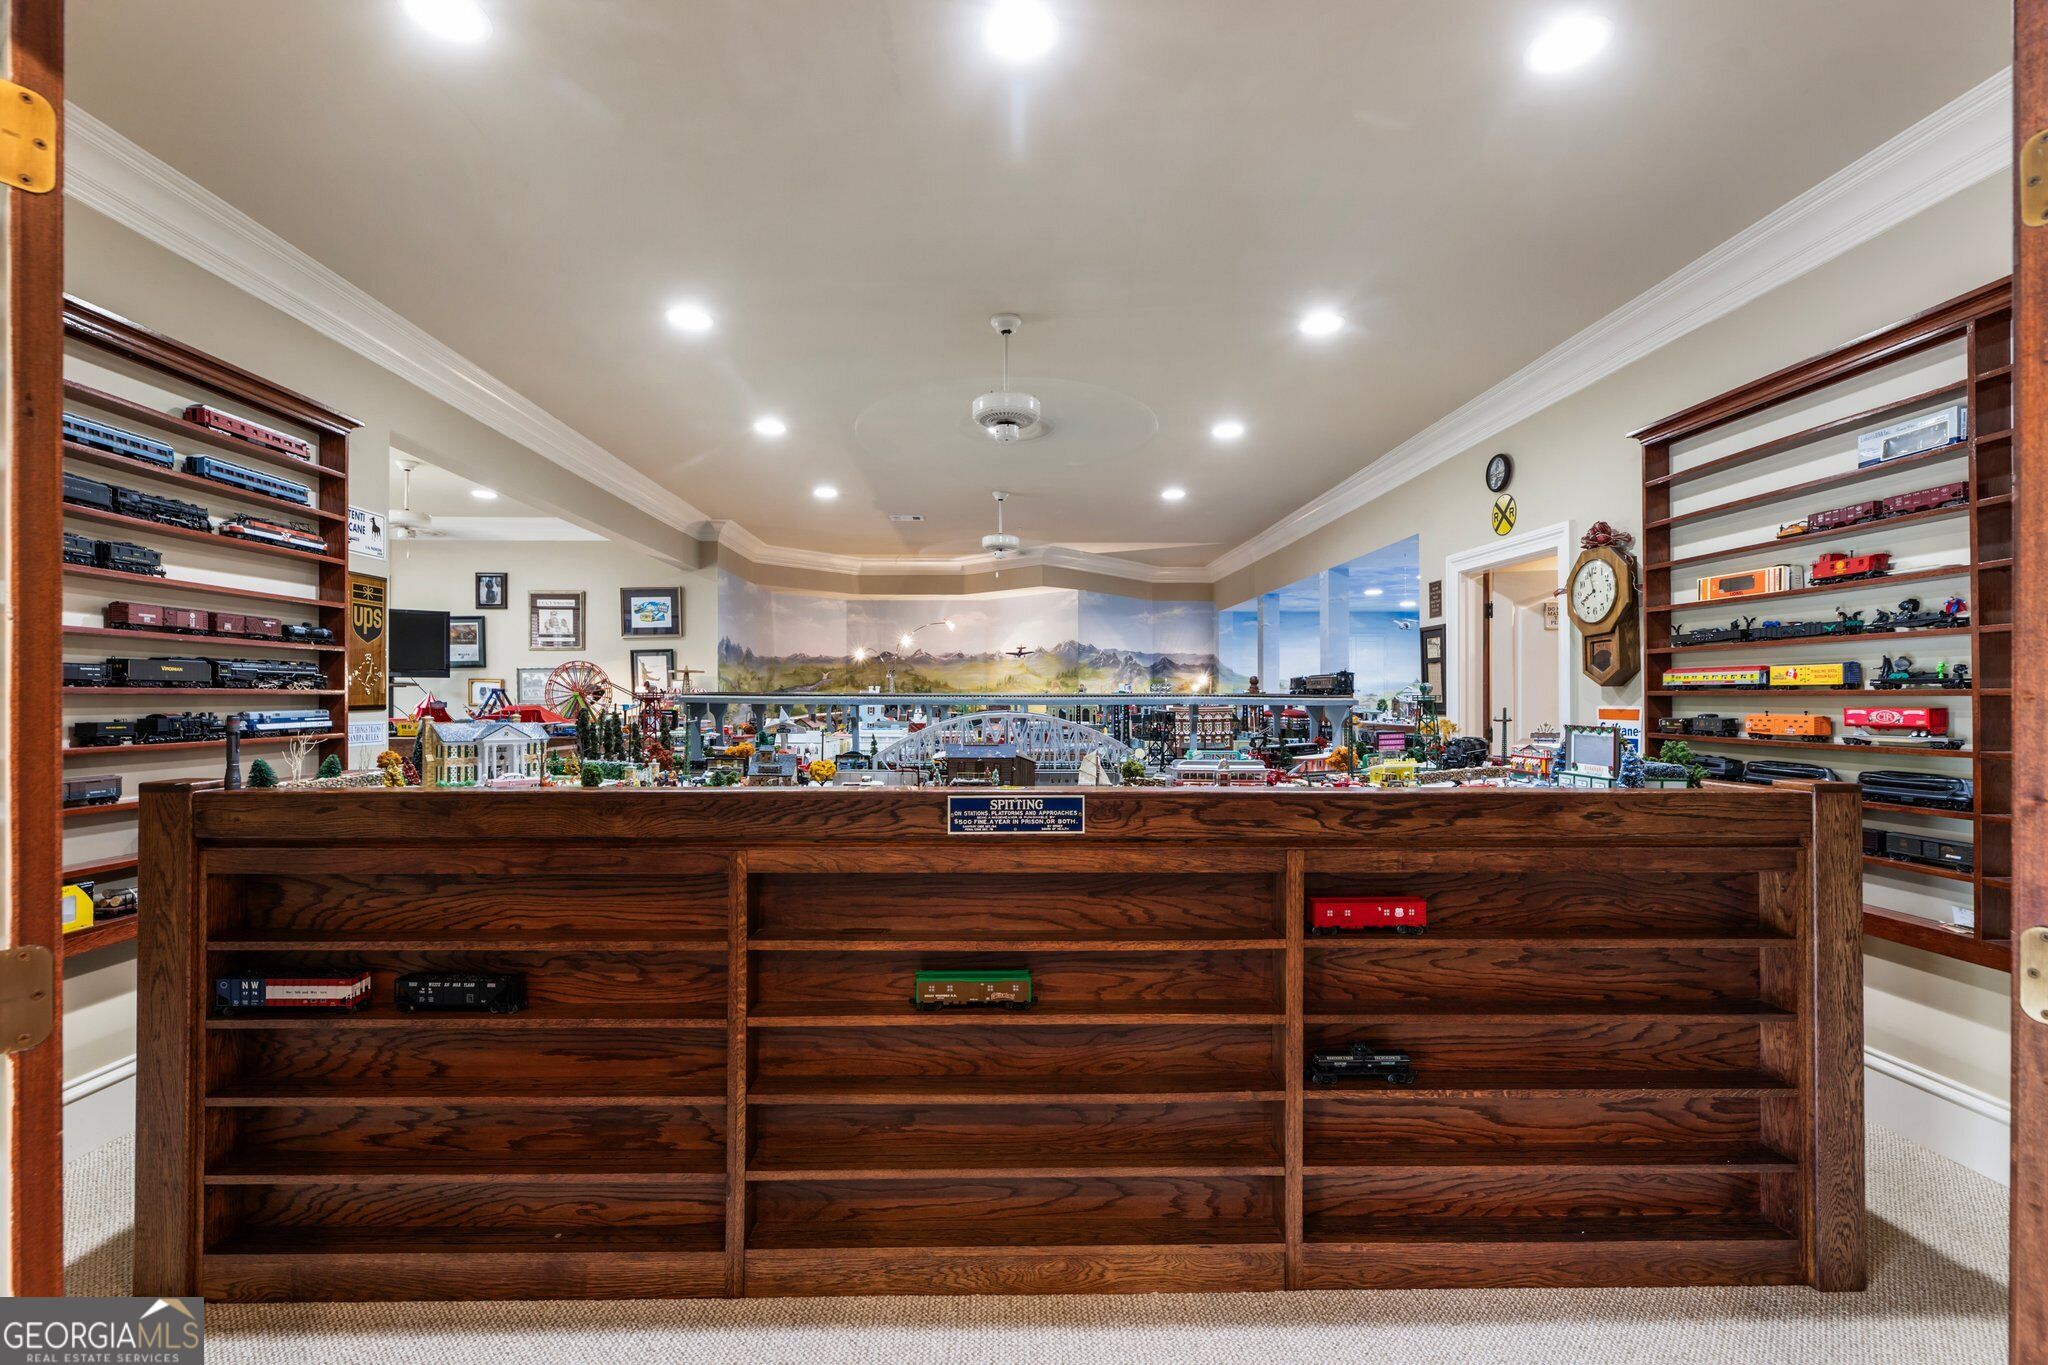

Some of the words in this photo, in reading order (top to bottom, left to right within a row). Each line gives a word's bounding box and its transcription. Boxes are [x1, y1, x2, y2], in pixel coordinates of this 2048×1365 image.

[1494, 512, 1499, 523] R
[1509, 507, 1514, 518] R
[353, 606, 382, 634] ups
[990, 799, 1043, 810] SPITTING
